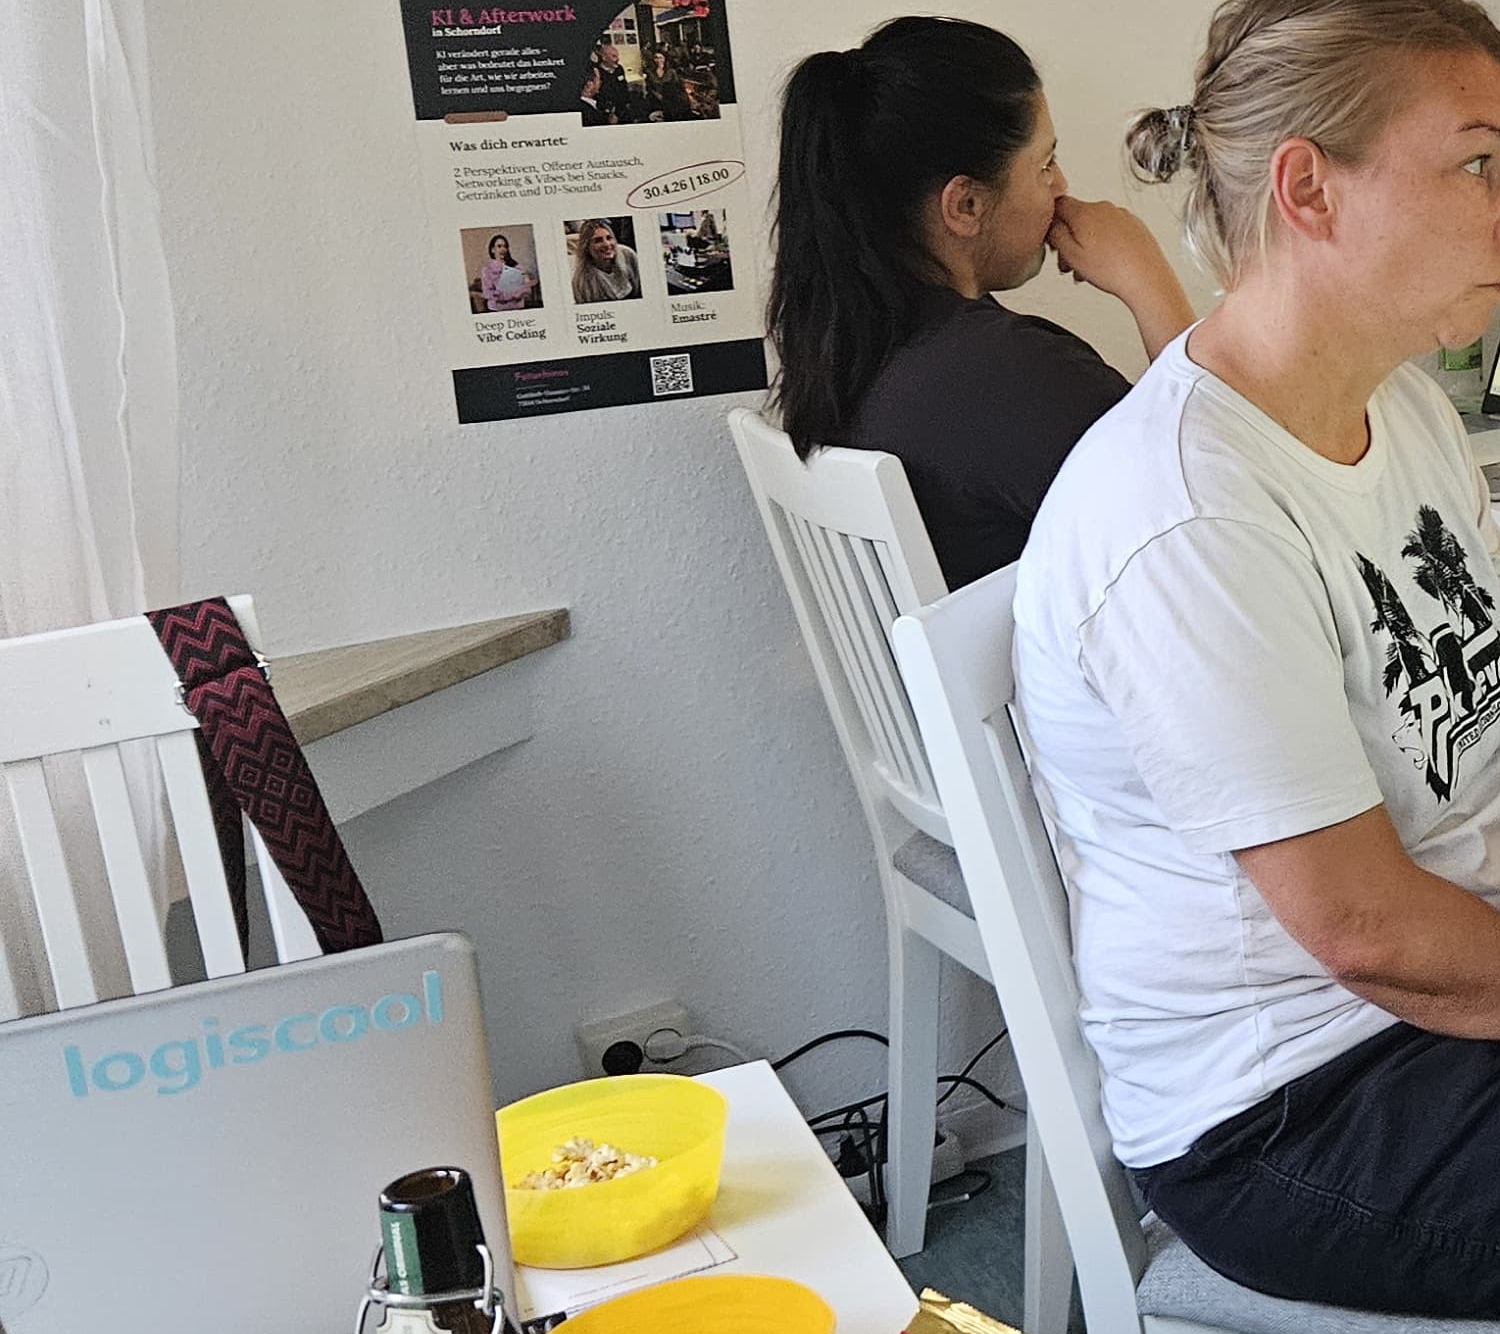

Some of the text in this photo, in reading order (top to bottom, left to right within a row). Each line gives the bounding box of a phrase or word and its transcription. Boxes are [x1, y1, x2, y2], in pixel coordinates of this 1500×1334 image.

[431, 5, 577, 26] KI & Afterwork
[431, 25, 502, 37] in Schorndorf
[449, 137, 568, 153] Was dich erwartet:
[453, 168, 461, 178] 2
[455, 176, 522, 190] Networking
[642, 179, 688, 201] 30.4.26
[696, 168, 730, 187] 18.00
[456, 189, 517, 202] Getränken
[519, 187, 541, 198] und
[475, 318, 537, 333] Deep Dive:
[577, 322, 616, 334] Soziale
[476, 328, 547, 343] Vibe Coding
[578, 331, 628, 344] Wirkung
[62, 969, 444, 1098] logiscool
